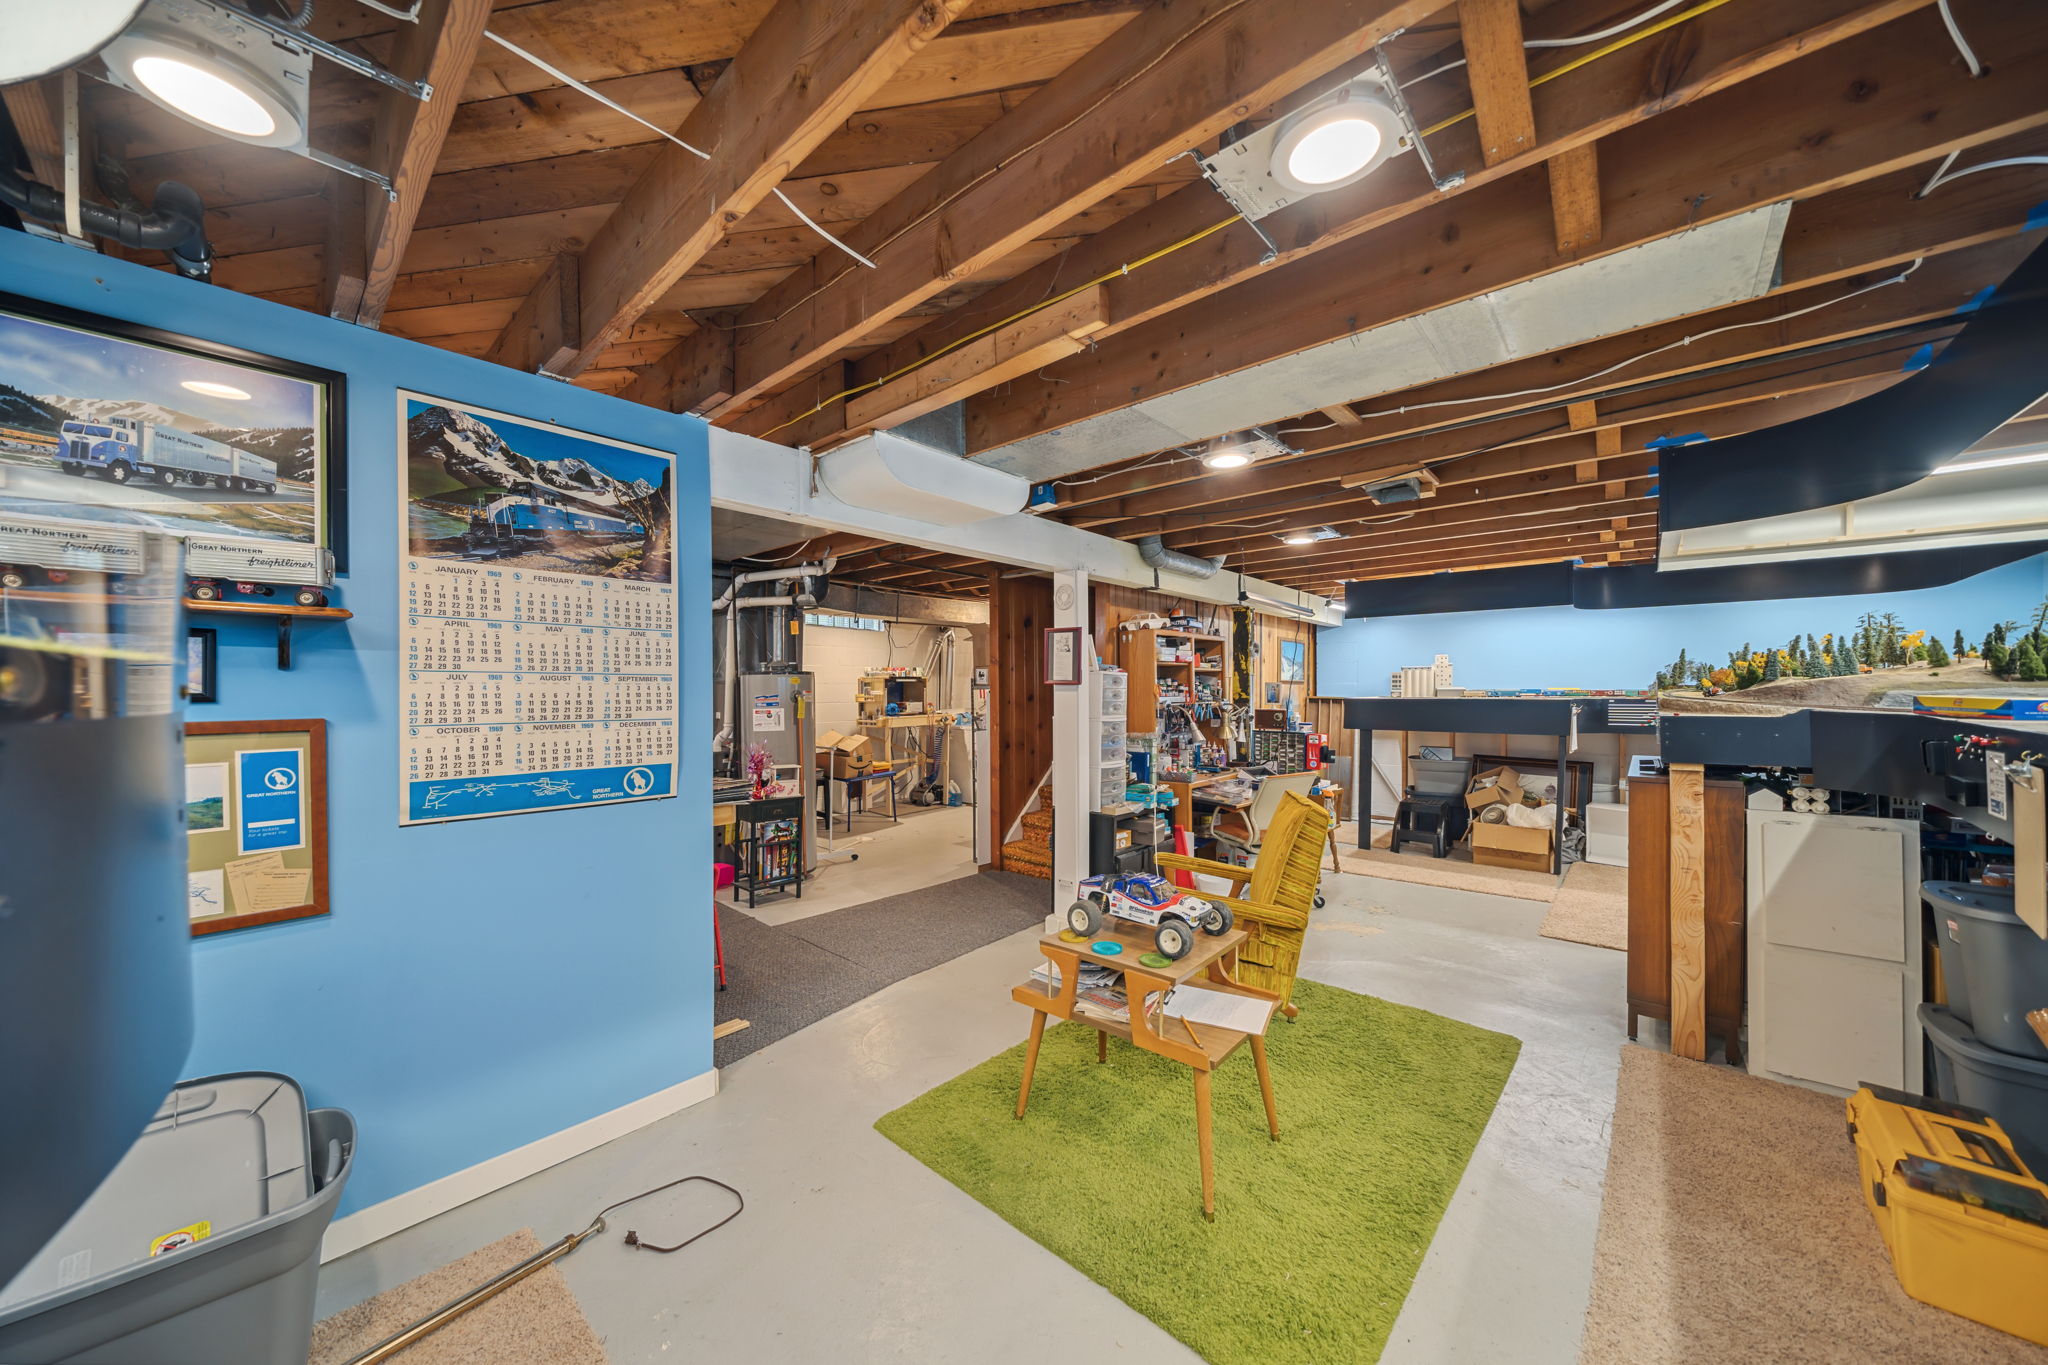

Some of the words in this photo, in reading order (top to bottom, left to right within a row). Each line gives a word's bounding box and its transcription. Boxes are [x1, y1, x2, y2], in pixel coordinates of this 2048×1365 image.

[0, 526, 29, 534] REAT
[191, 542, 218, 551] GREAT
[220, 544, 263, 554] NORTHERN
[247, 556, 316, 569] freightliner
[435, 565, 478, 575] JANUARY
[533, 575, 575, 585] FEBRUARY
[624, 584, 651, 592] MARCH
[436, 726, 480, 734] OCTOBER
